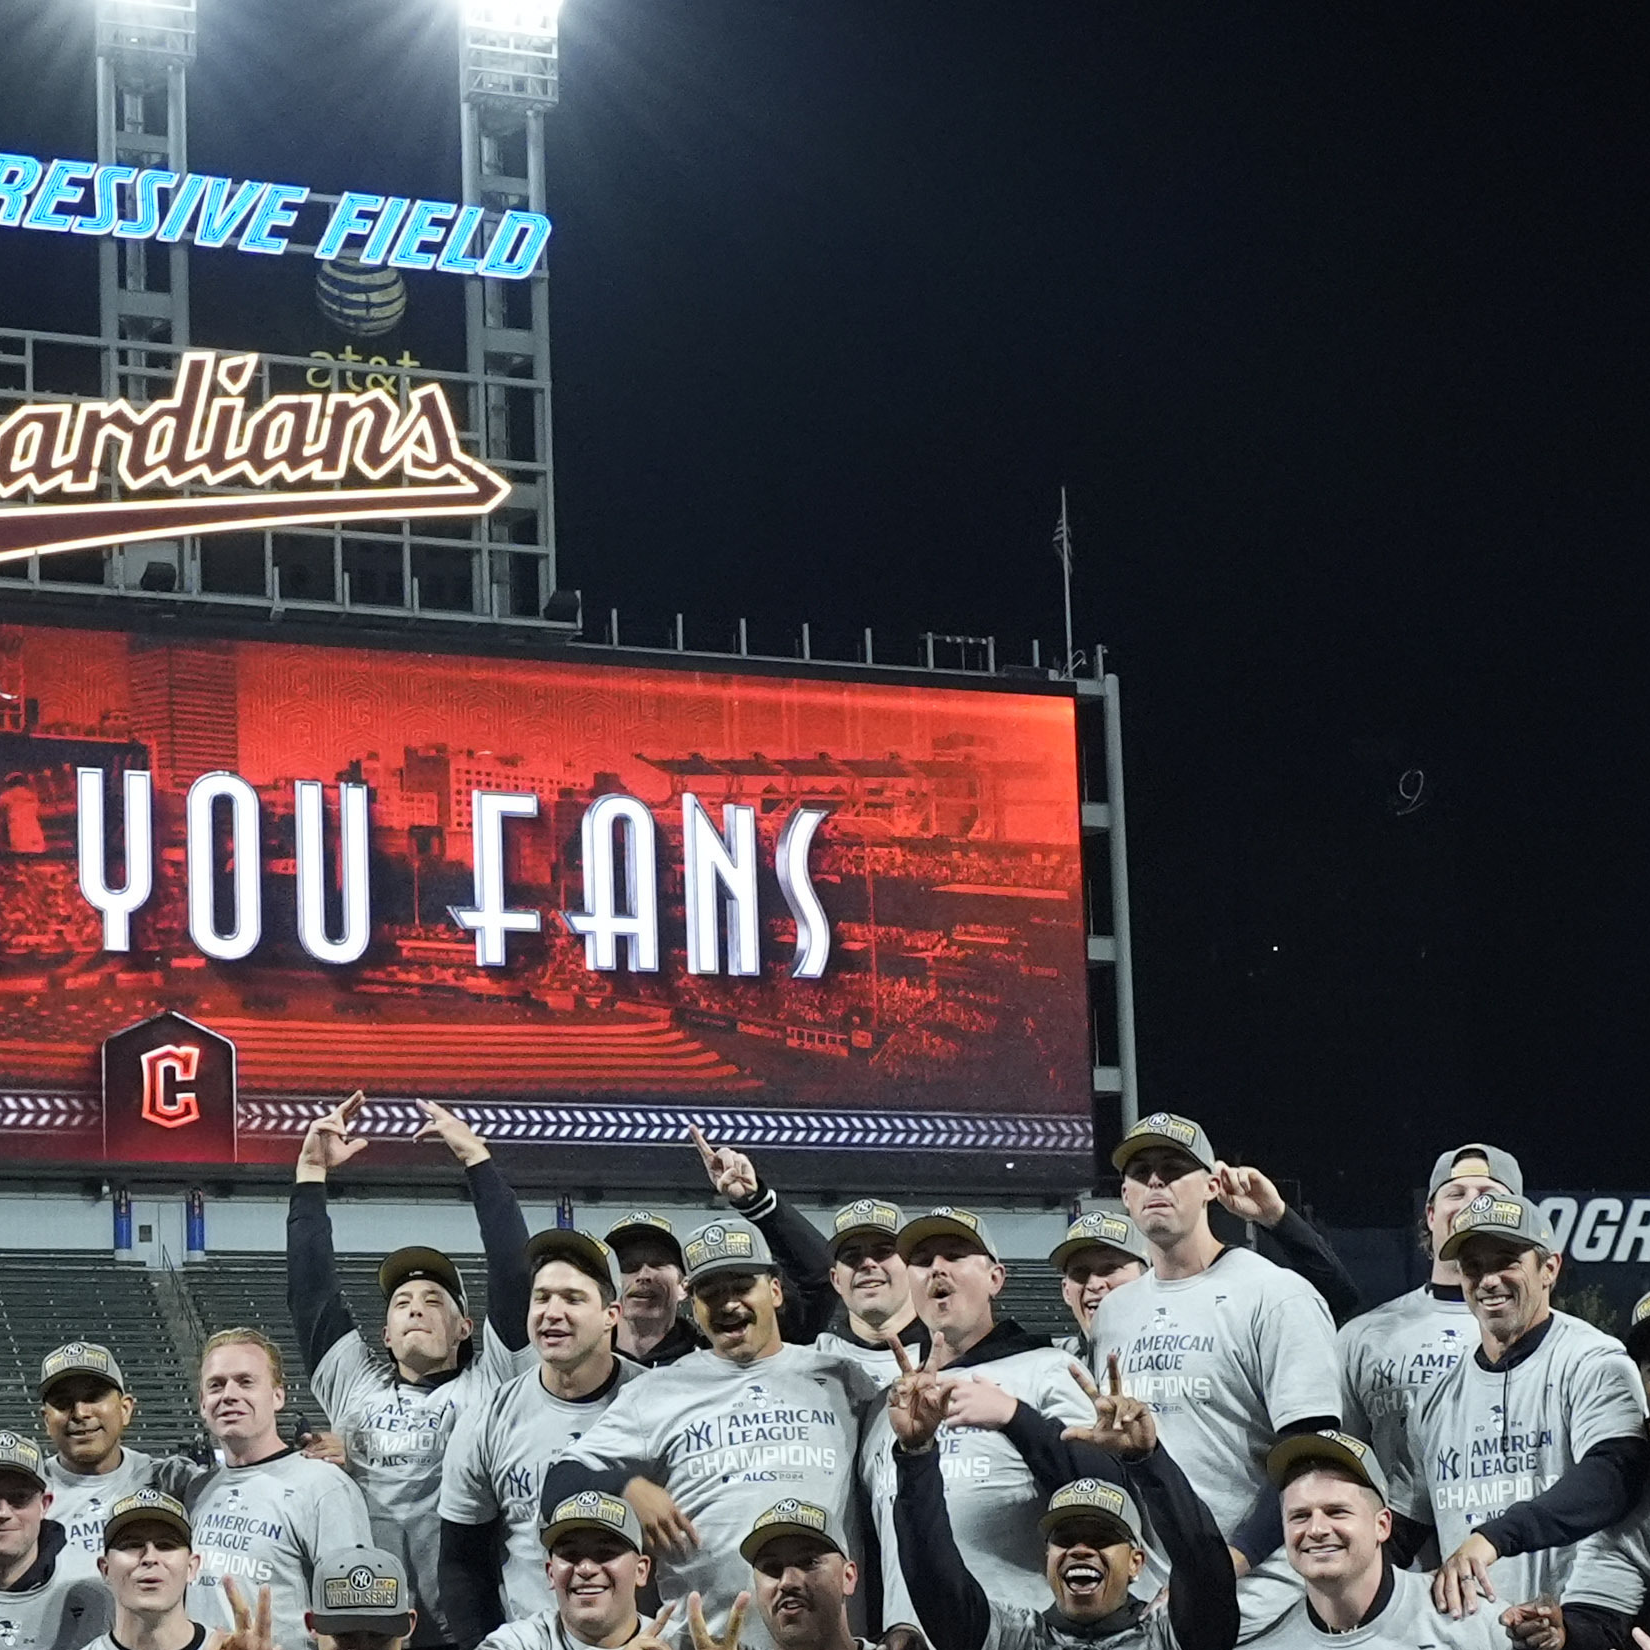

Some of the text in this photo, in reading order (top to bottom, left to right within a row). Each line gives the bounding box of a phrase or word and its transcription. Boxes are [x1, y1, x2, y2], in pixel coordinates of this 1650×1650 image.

[315, 191, 551, 280] FIELD
[76, 767, 829, 980] YOU FANS
[1132, 1335, 1214, 1354] AMERICAN
[1128, 1353, 1183, 1374] LEAGUE
[728, 1409, 835, 1428] AMERICAN
[728, 1426, 810, 1446] LEAGUE
[687, 1446, 837, 1481] CHAMPIONS
[743, 1470, 777, 1482] ALCS
[204, 1514, 282, 1540] AMERICAN
[198, 1532, 252, 1551] LEAGUE
[326, 1590, 396, 1606] WORLD SERIES
